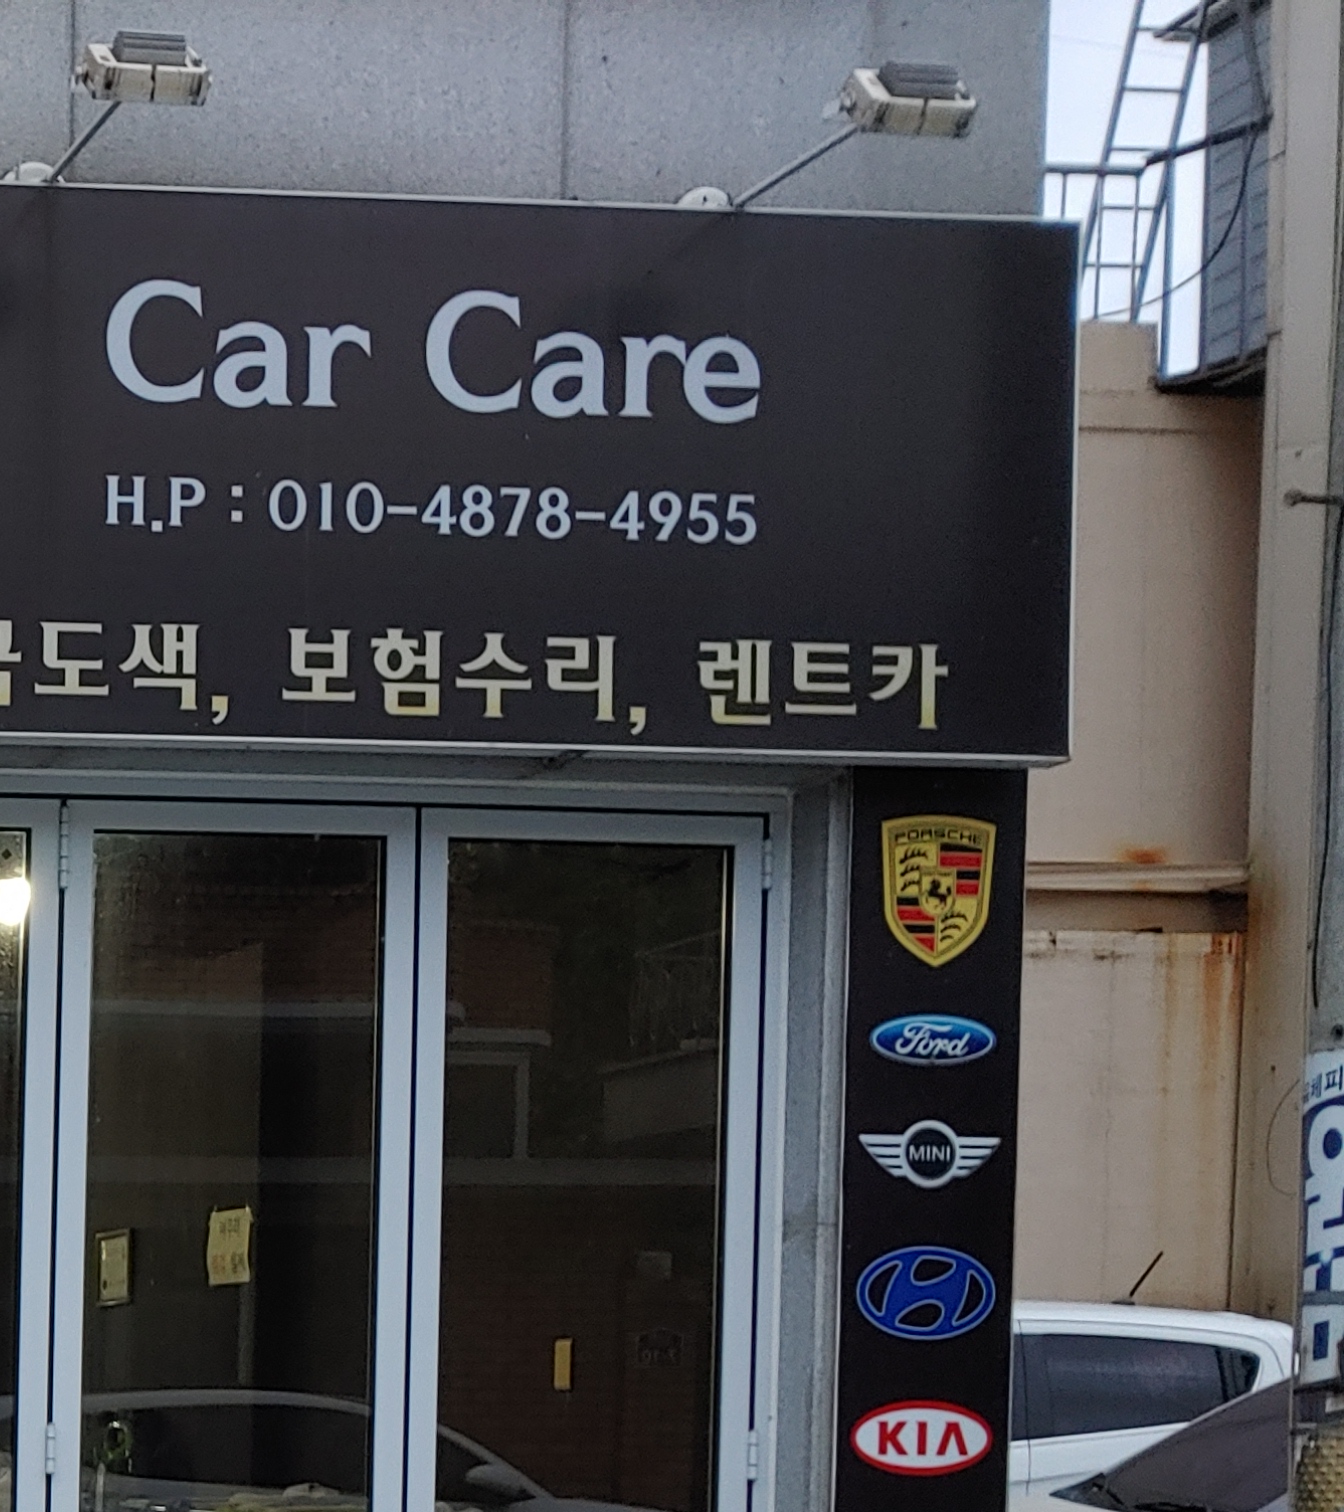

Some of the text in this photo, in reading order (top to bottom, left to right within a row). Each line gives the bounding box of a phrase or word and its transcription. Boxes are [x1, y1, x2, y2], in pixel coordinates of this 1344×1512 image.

[106, 279, 761, 424] Car Care
[269, 479, 757, 545] 010-4878-4955
[281, 628, 648, 735] 보험수리,
[697, 639, 949, 729] 렌트카
[895, 828, 982, 845] PORSCHE
[895, 1022, 971, 1056] Ford
[909, 1145, 951, 1164] MINI
[877, 1420, 969, 1457] KIA
